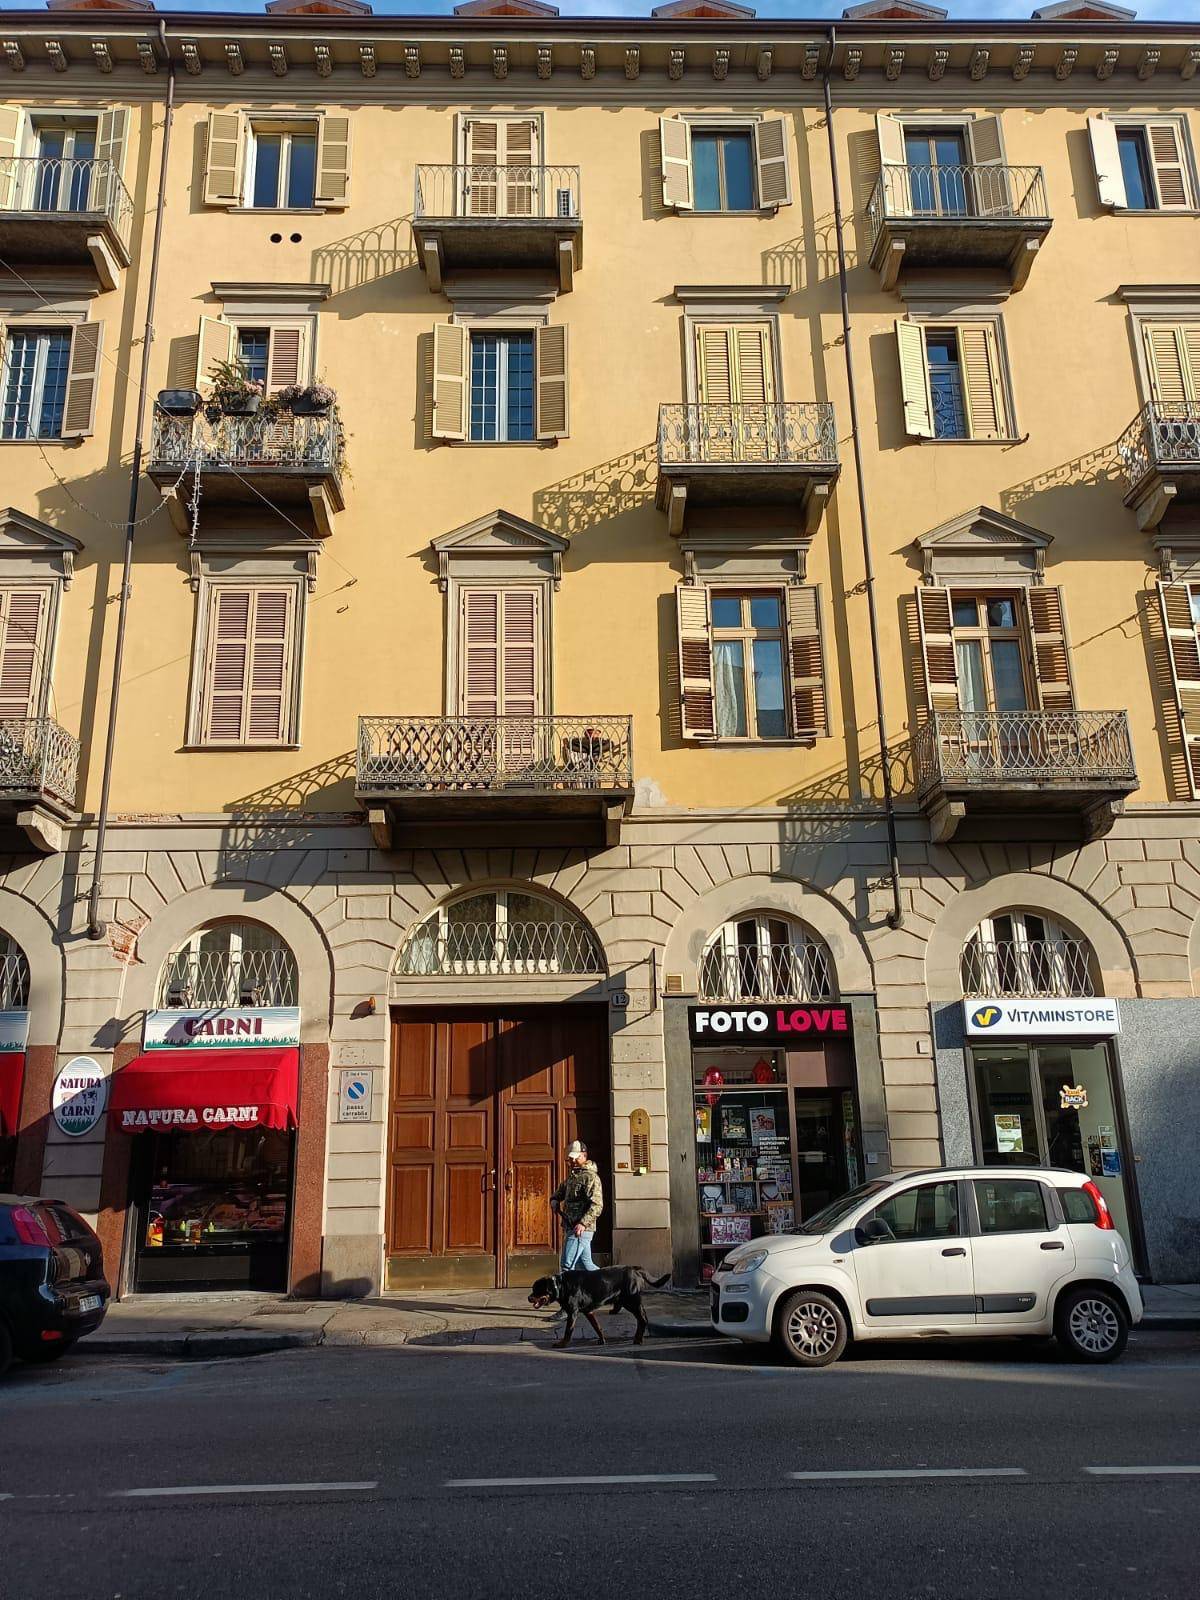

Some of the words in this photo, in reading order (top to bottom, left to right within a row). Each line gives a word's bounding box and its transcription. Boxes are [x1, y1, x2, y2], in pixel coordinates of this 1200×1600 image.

[615, 994, 627, 1005] 12
[696, 1010, 769, 1033] FOTO
[776, 1009, 848, 1032] LOVE
[1007, 1009, 1115, 1025] VITAMINSTORE
[184, 1018, 262, 1036] CARNI
[60, 1078, 102, 1089] NATURA
[62, 1105, 95, 1117] CARNI
[122, 1109, 198, 1126] NATURA
[203, 1106, 258, 1123] CARNI
